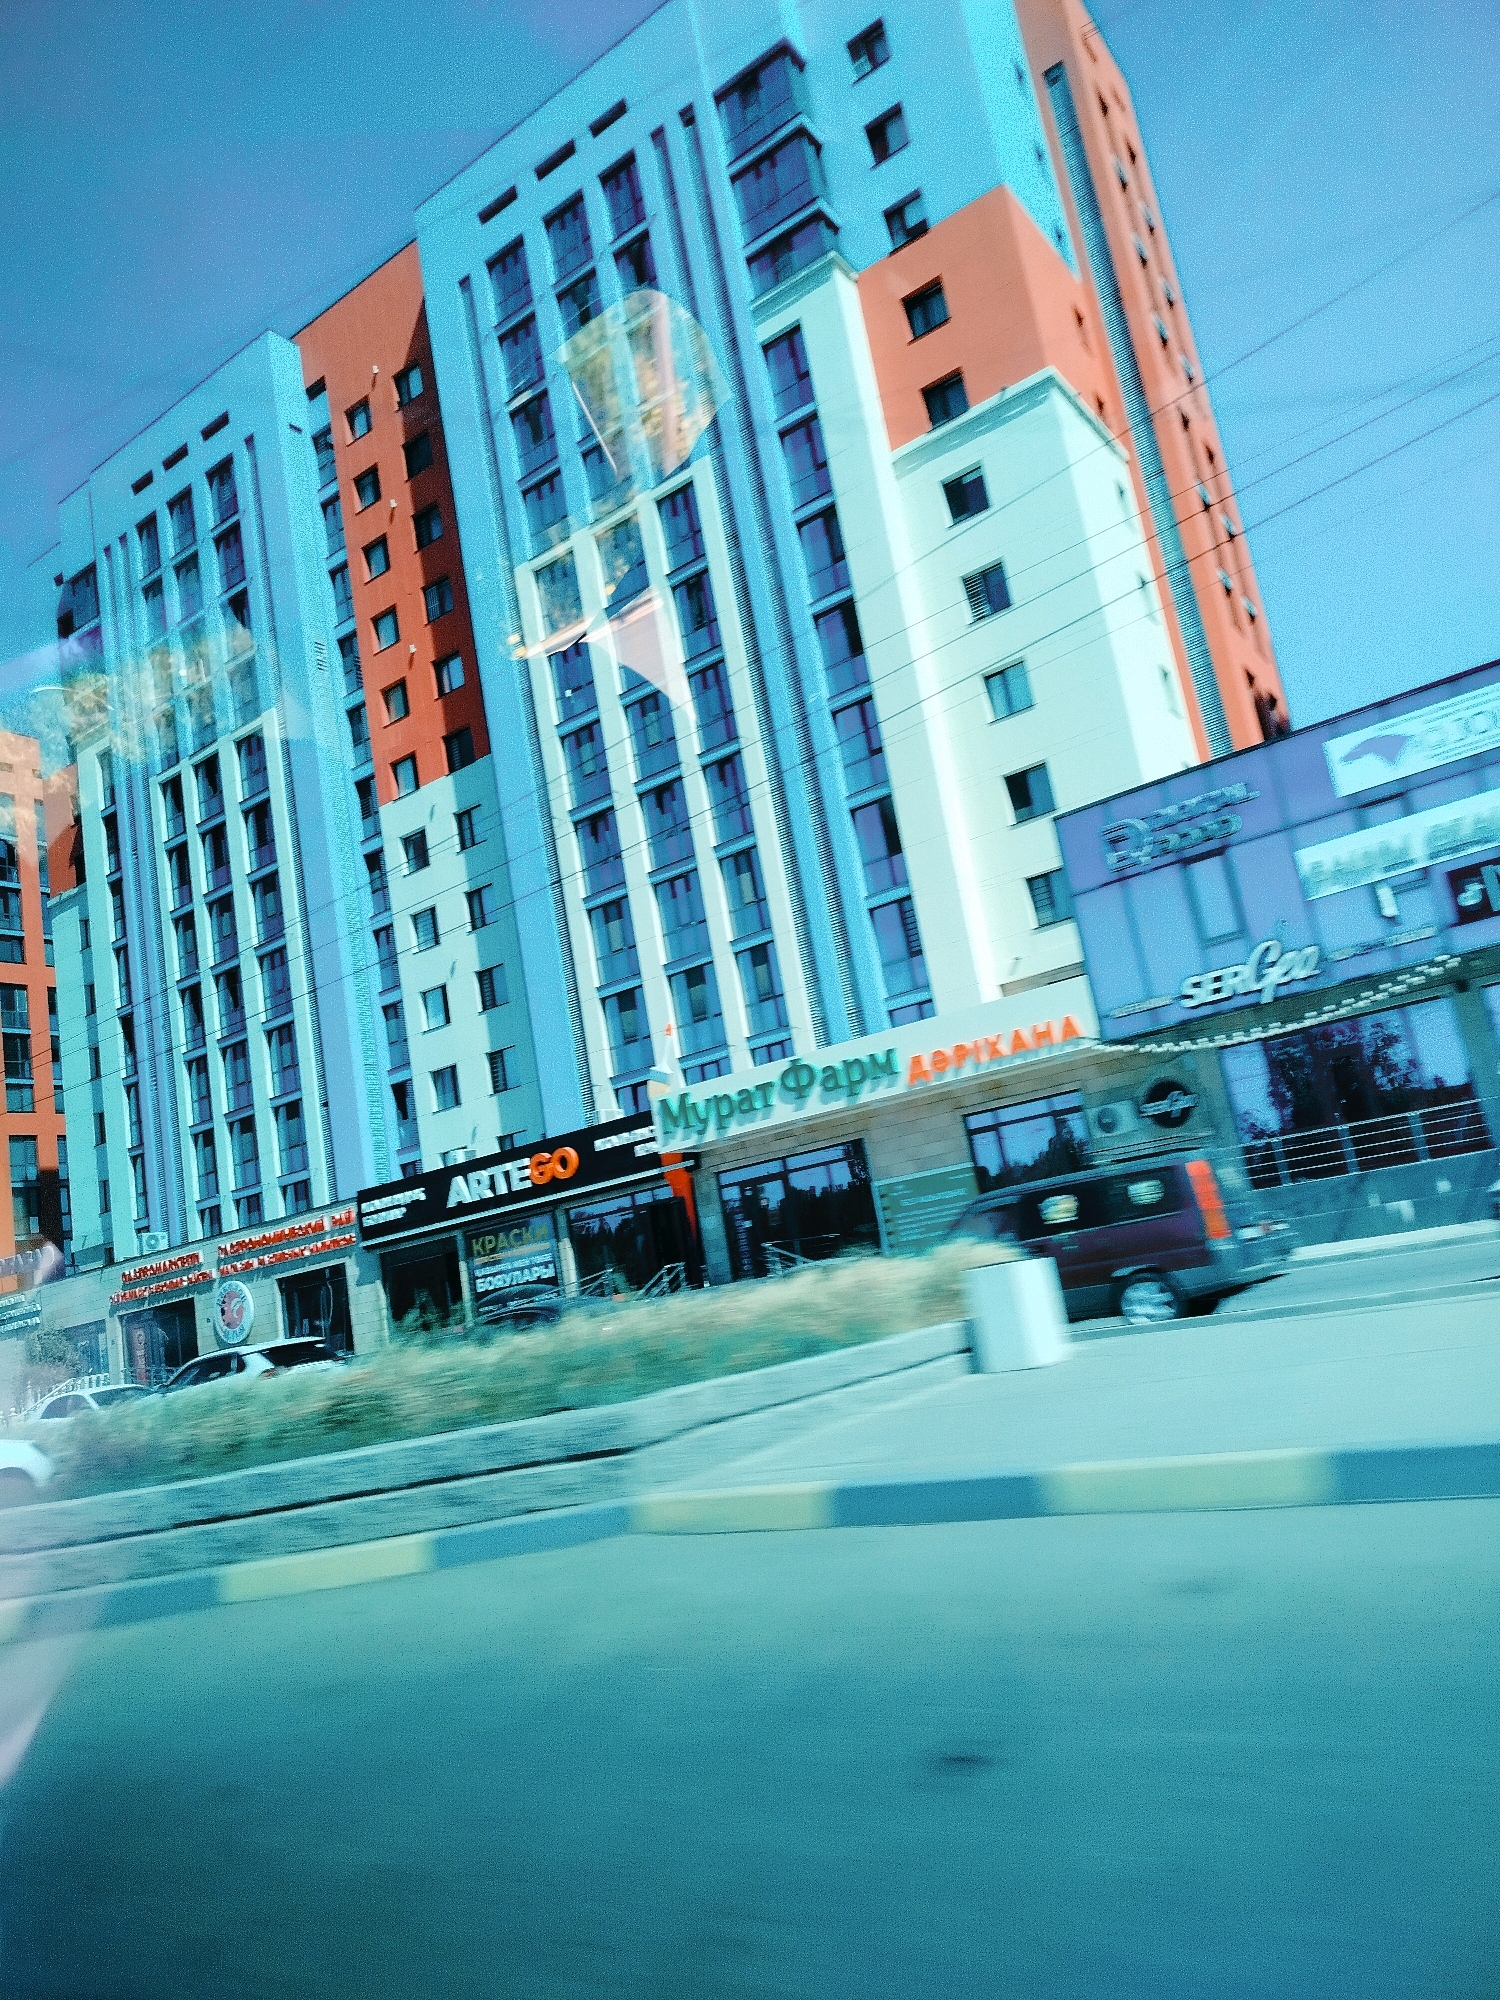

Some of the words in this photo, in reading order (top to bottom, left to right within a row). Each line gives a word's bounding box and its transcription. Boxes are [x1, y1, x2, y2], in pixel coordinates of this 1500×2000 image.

[907, 1015, 1082, 1087] ДӘРІХАНА
[446, 1147, 579, 1208] ARTEGO
[472, 1222, 550, 1257] КРАСКИ
